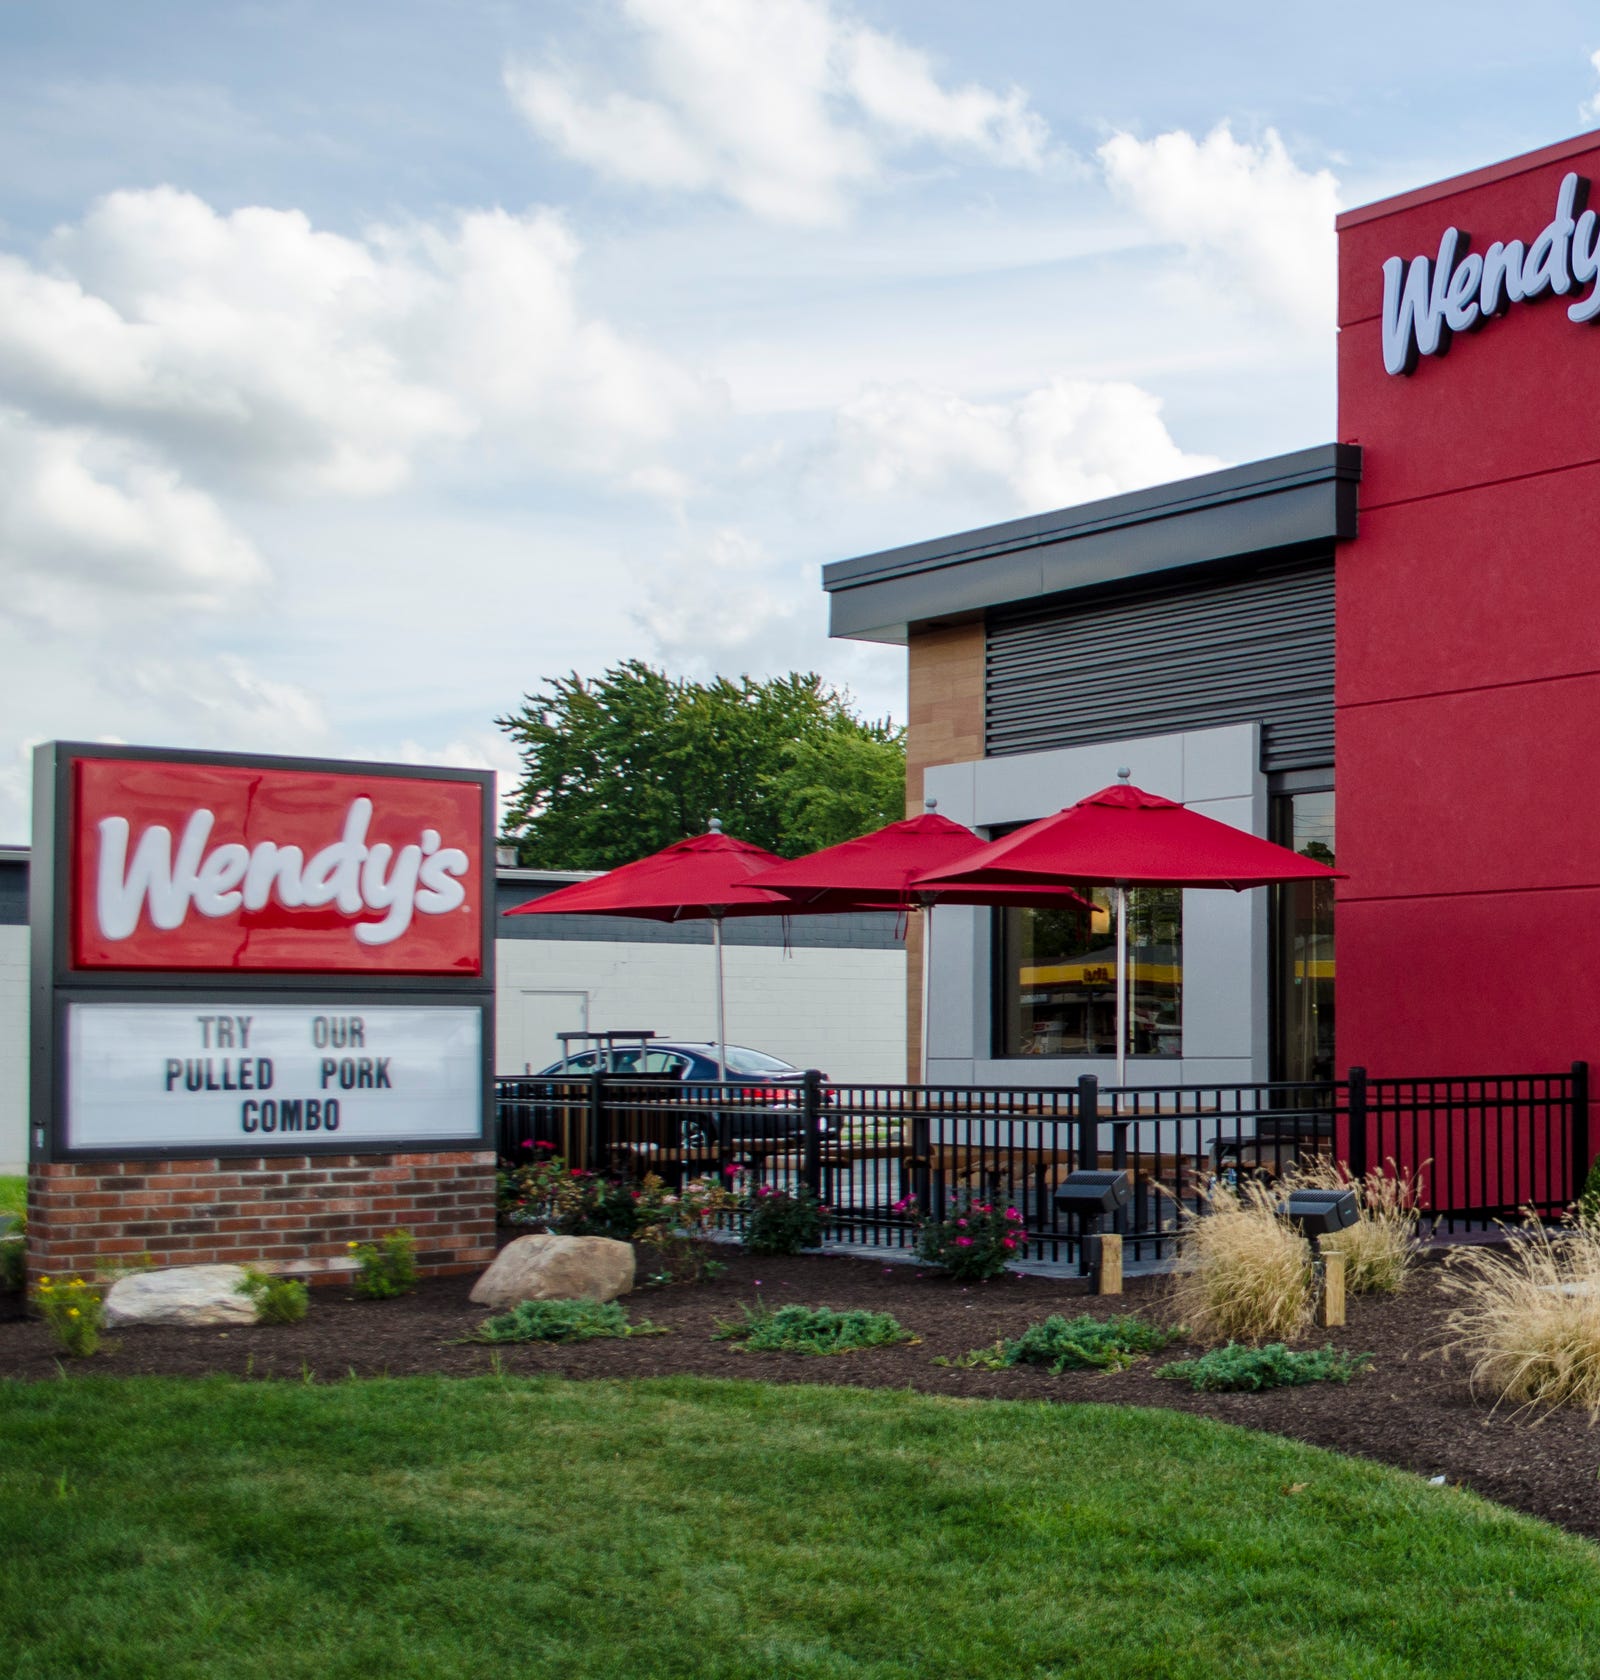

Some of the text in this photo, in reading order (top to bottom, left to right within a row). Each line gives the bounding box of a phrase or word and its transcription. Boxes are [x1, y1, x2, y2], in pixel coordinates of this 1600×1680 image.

[97, 796, 470, 946] Wendy's
[197, 1015, 365, 1049] TRY OUR
[165, 1056, 392, 1092] PULLED PORK
[241, 1098, 341, 1133] COMBO
